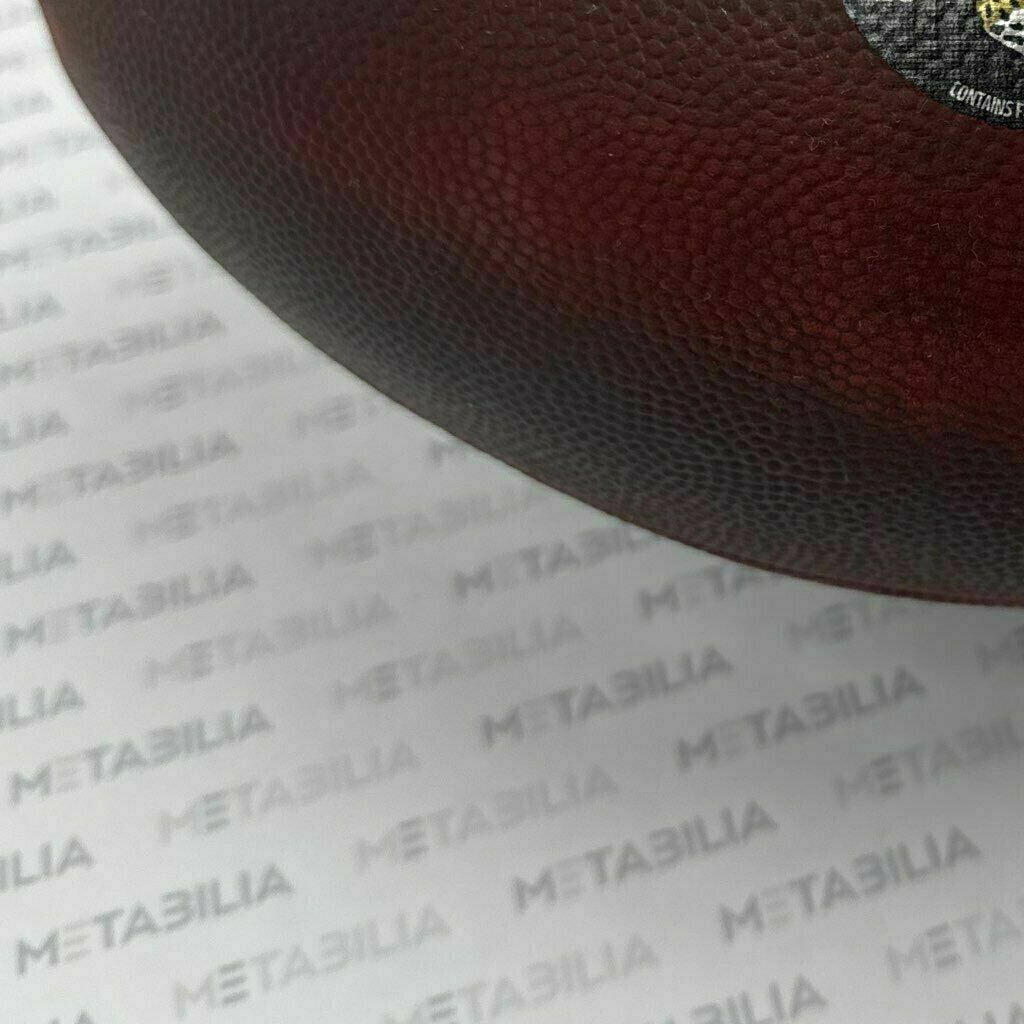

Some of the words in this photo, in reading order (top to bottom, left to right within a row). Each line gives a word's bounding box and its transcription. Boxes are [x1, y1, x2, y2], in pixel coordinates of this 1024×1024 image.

[949, 81, 1014, 117] CONTAINS
[9, 704, 275, 807] METABILIA
[511, 799, 779, 916] METABILIA
[718, 825, 982, 946] METABILIA
[14, 862, 295, 977] METABILIA
